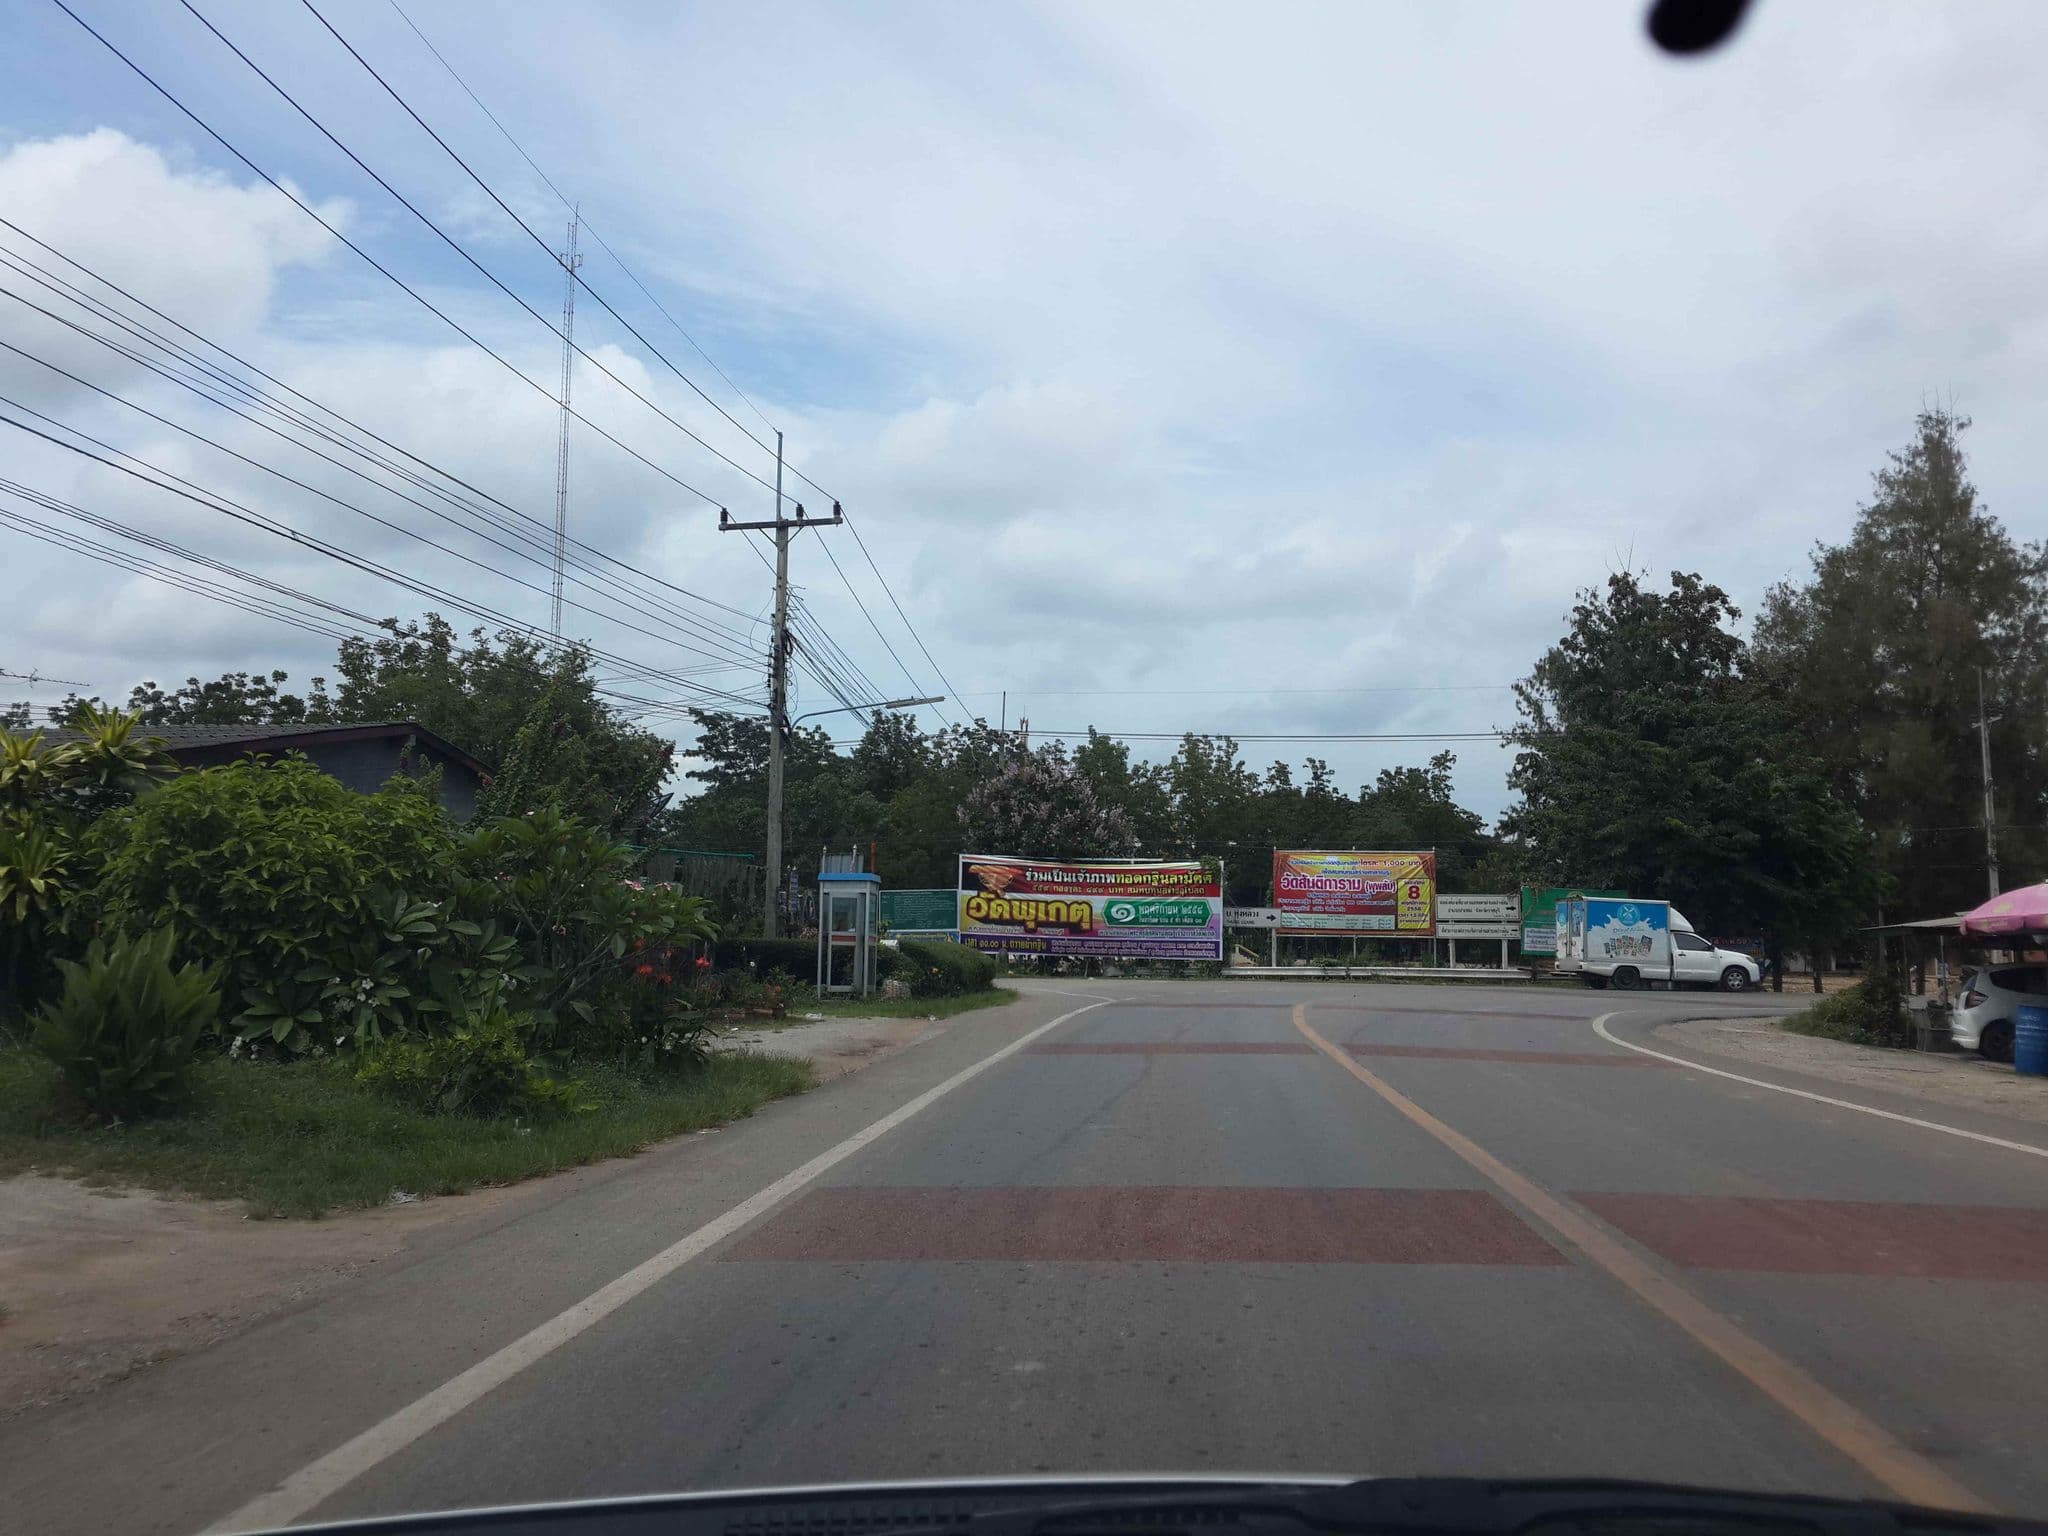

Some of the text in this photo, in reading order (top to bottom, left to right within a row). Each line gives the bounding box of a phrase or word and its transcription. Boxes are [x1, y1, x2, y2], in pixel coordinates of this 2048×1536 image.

[1025, 868, 1213, 886] ร่วมเป็นเจ้าภาพทอดกฐินสามัคคี
[1281, 873, 1361, 890] วัดสันติการาม
[1408, 885, 1420, 899] 8
[967, 891, 1091, 930] วัดพุเกตุ
